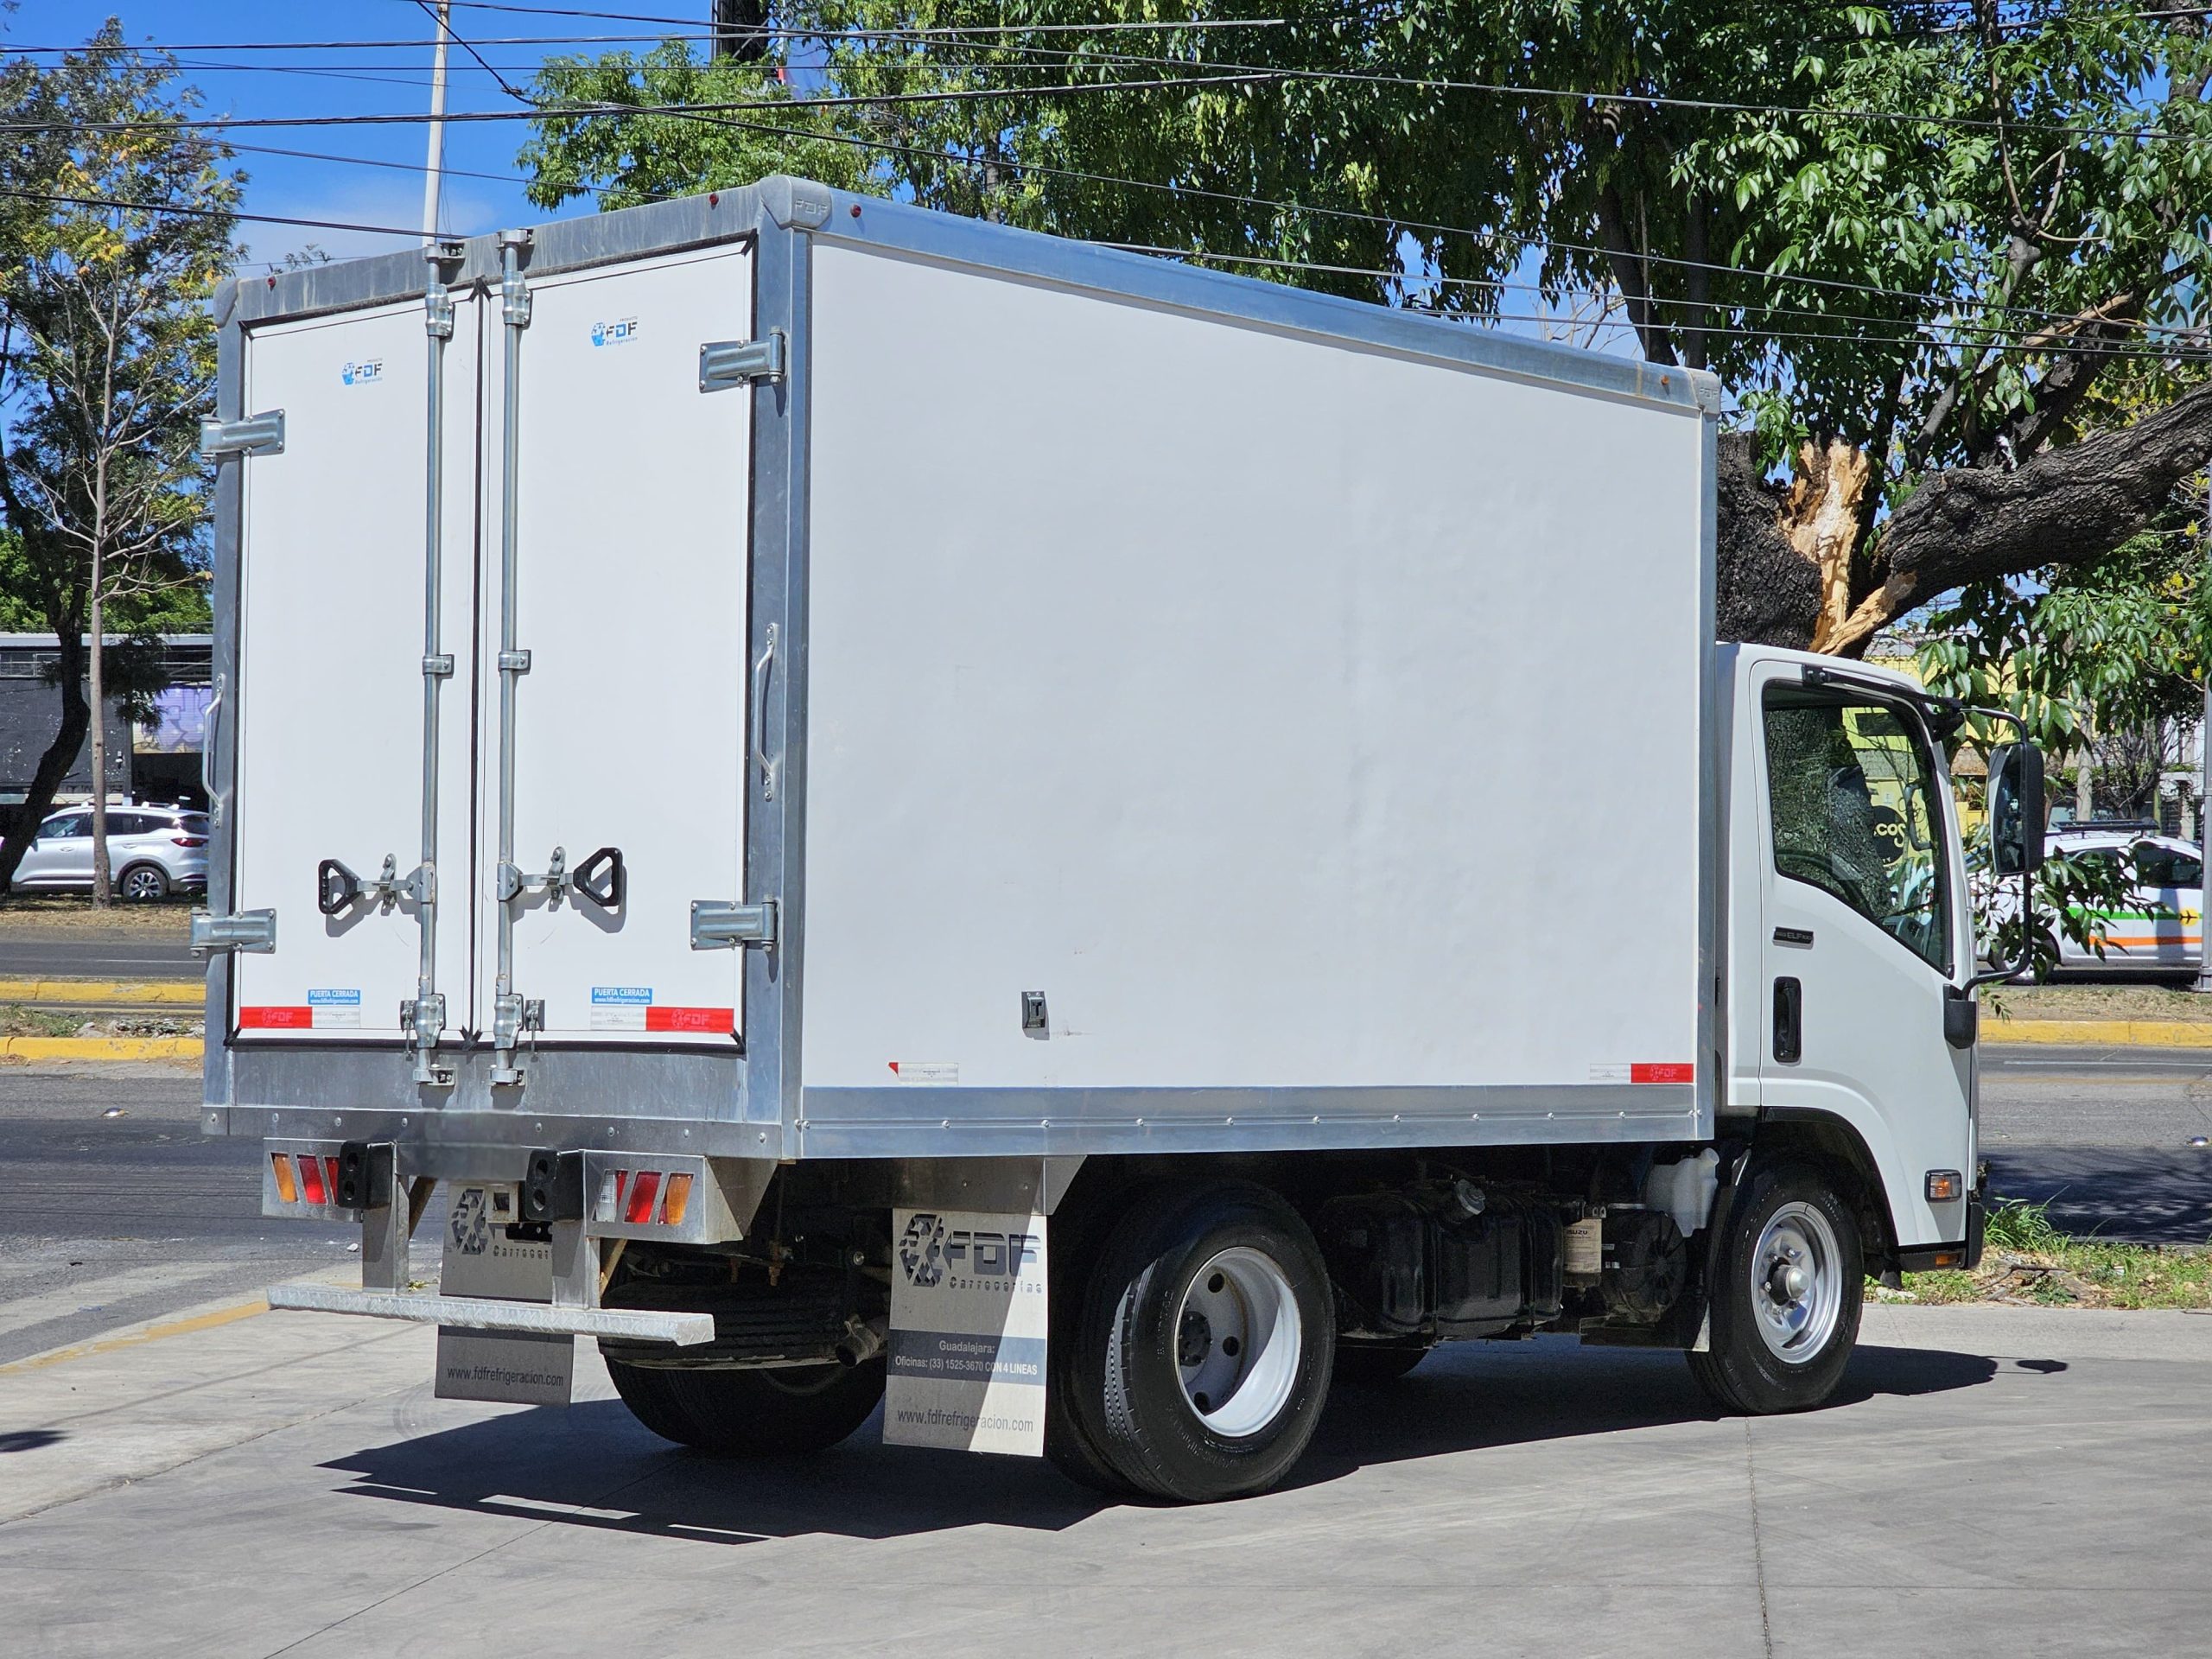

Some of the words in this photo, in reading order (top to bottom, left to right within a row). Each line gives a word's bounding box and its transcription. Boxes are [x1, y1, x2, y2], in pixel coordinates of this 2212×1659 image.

[606, 321, 638, 338] FDF
[354, 363, 383, 378] FDF
[594, 988, 619, 996] PUERTA
[619, 988, 650, 997] CERRADA
[270, 1011, 294, 1023] FDF
[683, 1013, 711, 1026] FDF
[942, 1230, 1042, 1276] FDF
[949, 1276, 1043, 1294] Carrocerias
[938, 1339, 995, 1355] Guadalajara:
[894, 1356, 928, 1369] Oficinas:
[929, 1358, 944, 1371] (33)
[945, 1359, 984, 1373] 1525-3670
[984, 1362, 1002, 1374] CON
[1002, 1363, 1009, 1374] 4
[1009, 1363, 1038, 1376] LINEAS
[447, 1365, 564, 1387] www.fdfrefrigeracion.com
[897, 1408, 1034, 1433] www.fdfrefrigeracion.com
